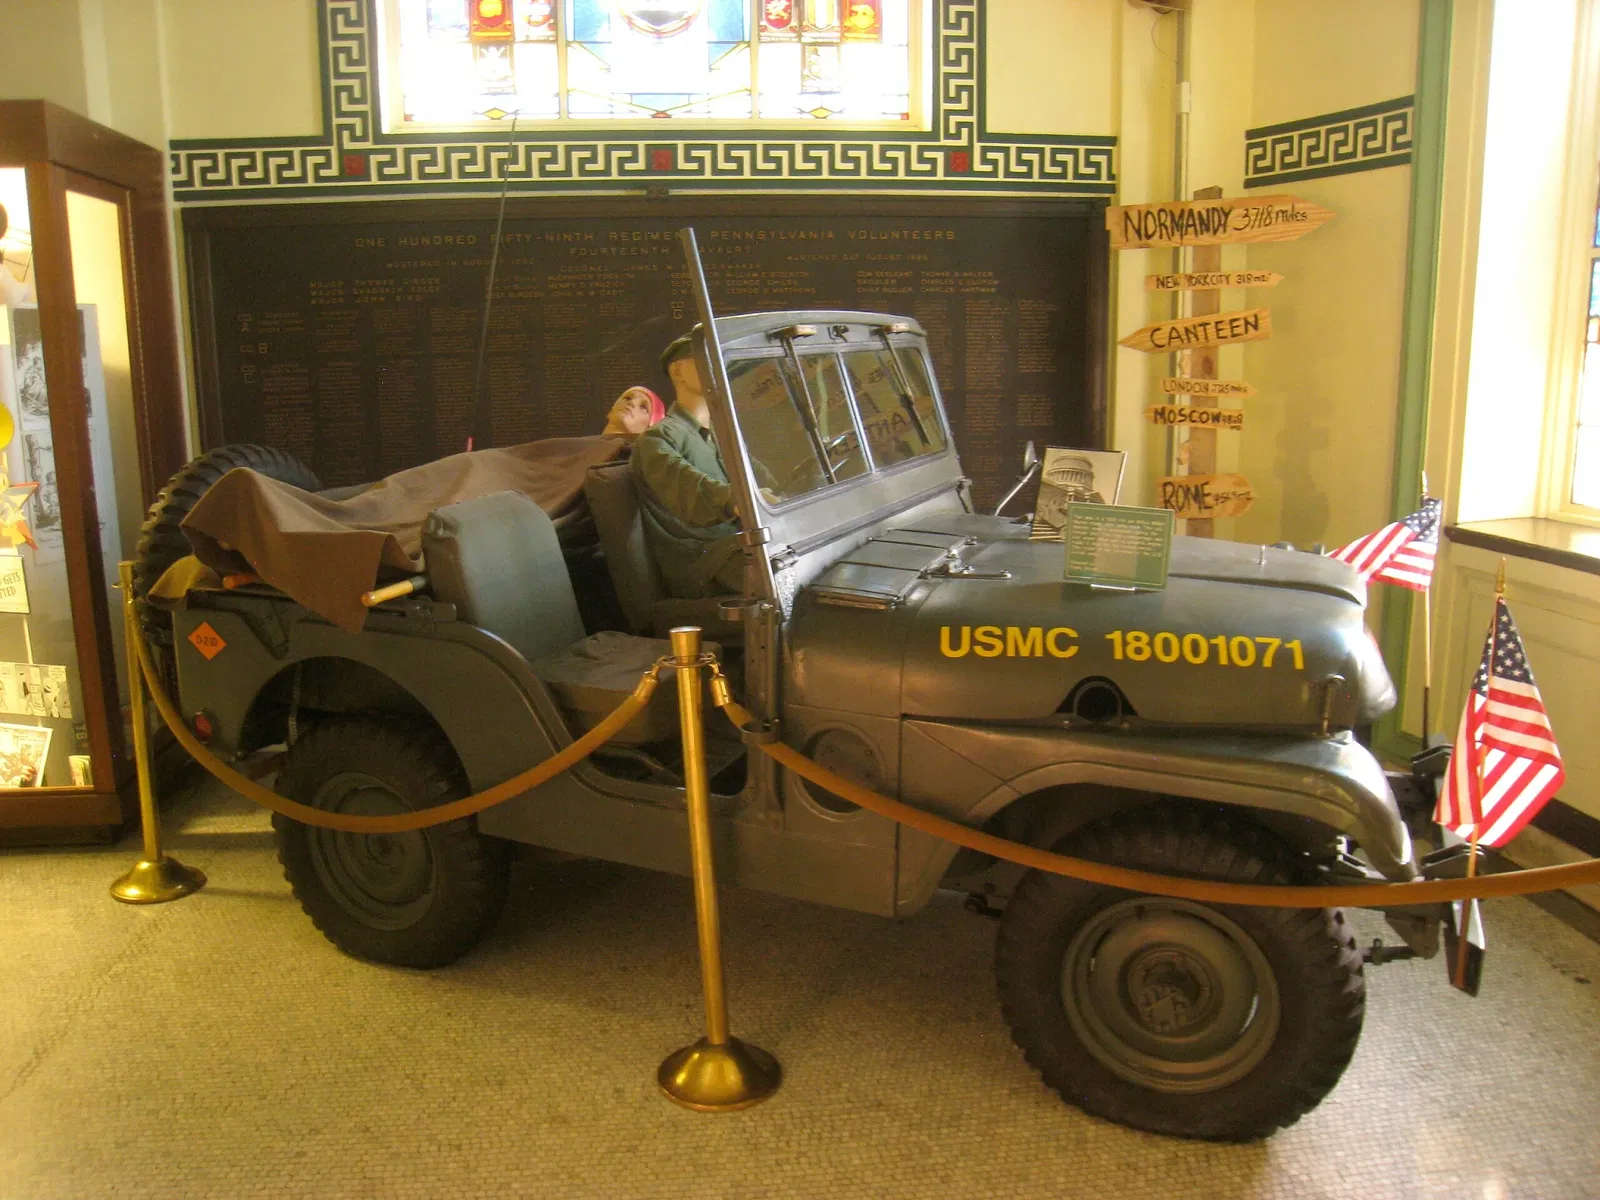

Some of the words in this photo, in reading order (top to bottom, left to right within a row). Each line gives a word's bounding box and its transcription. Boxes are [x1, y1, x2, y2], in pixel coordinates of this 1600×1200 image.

[1122, 205, 1234, 244] NORMANDY
[1233, 204, 1274, 232] 3718
[355, 237, 386, 248] ONE
[397, 234, 477, 246] HUNDRED
[489, 232, 594, 244] FIFTY-NINTH
[608, 230, 688, 242] REGIMEN
[709, 230, 835, 240] PENNSYLVANIA
[847, 230, 955, 240] VOLUNTEERS
[569, 246, 670, 257] FOURTEENTH
[1155, 274, 1180, 289] NEW
[1185, 273, 1210, 287] YORK
[1210, 273, 1231, 286] CITY
[1150, 313, 1260, 349] CANTEEN
[258, 342, 268, 354] B
[1162, 379, 1210, 395] LONDON
[1153, 405, 1222, 424] MOSCOW
[1162, 480, 1214, 514] ROME
[3, 571, 21, 585] GETS
[939, 625, 1080, 660] USMC
[1104, 629, 1306, 671] 18001071
